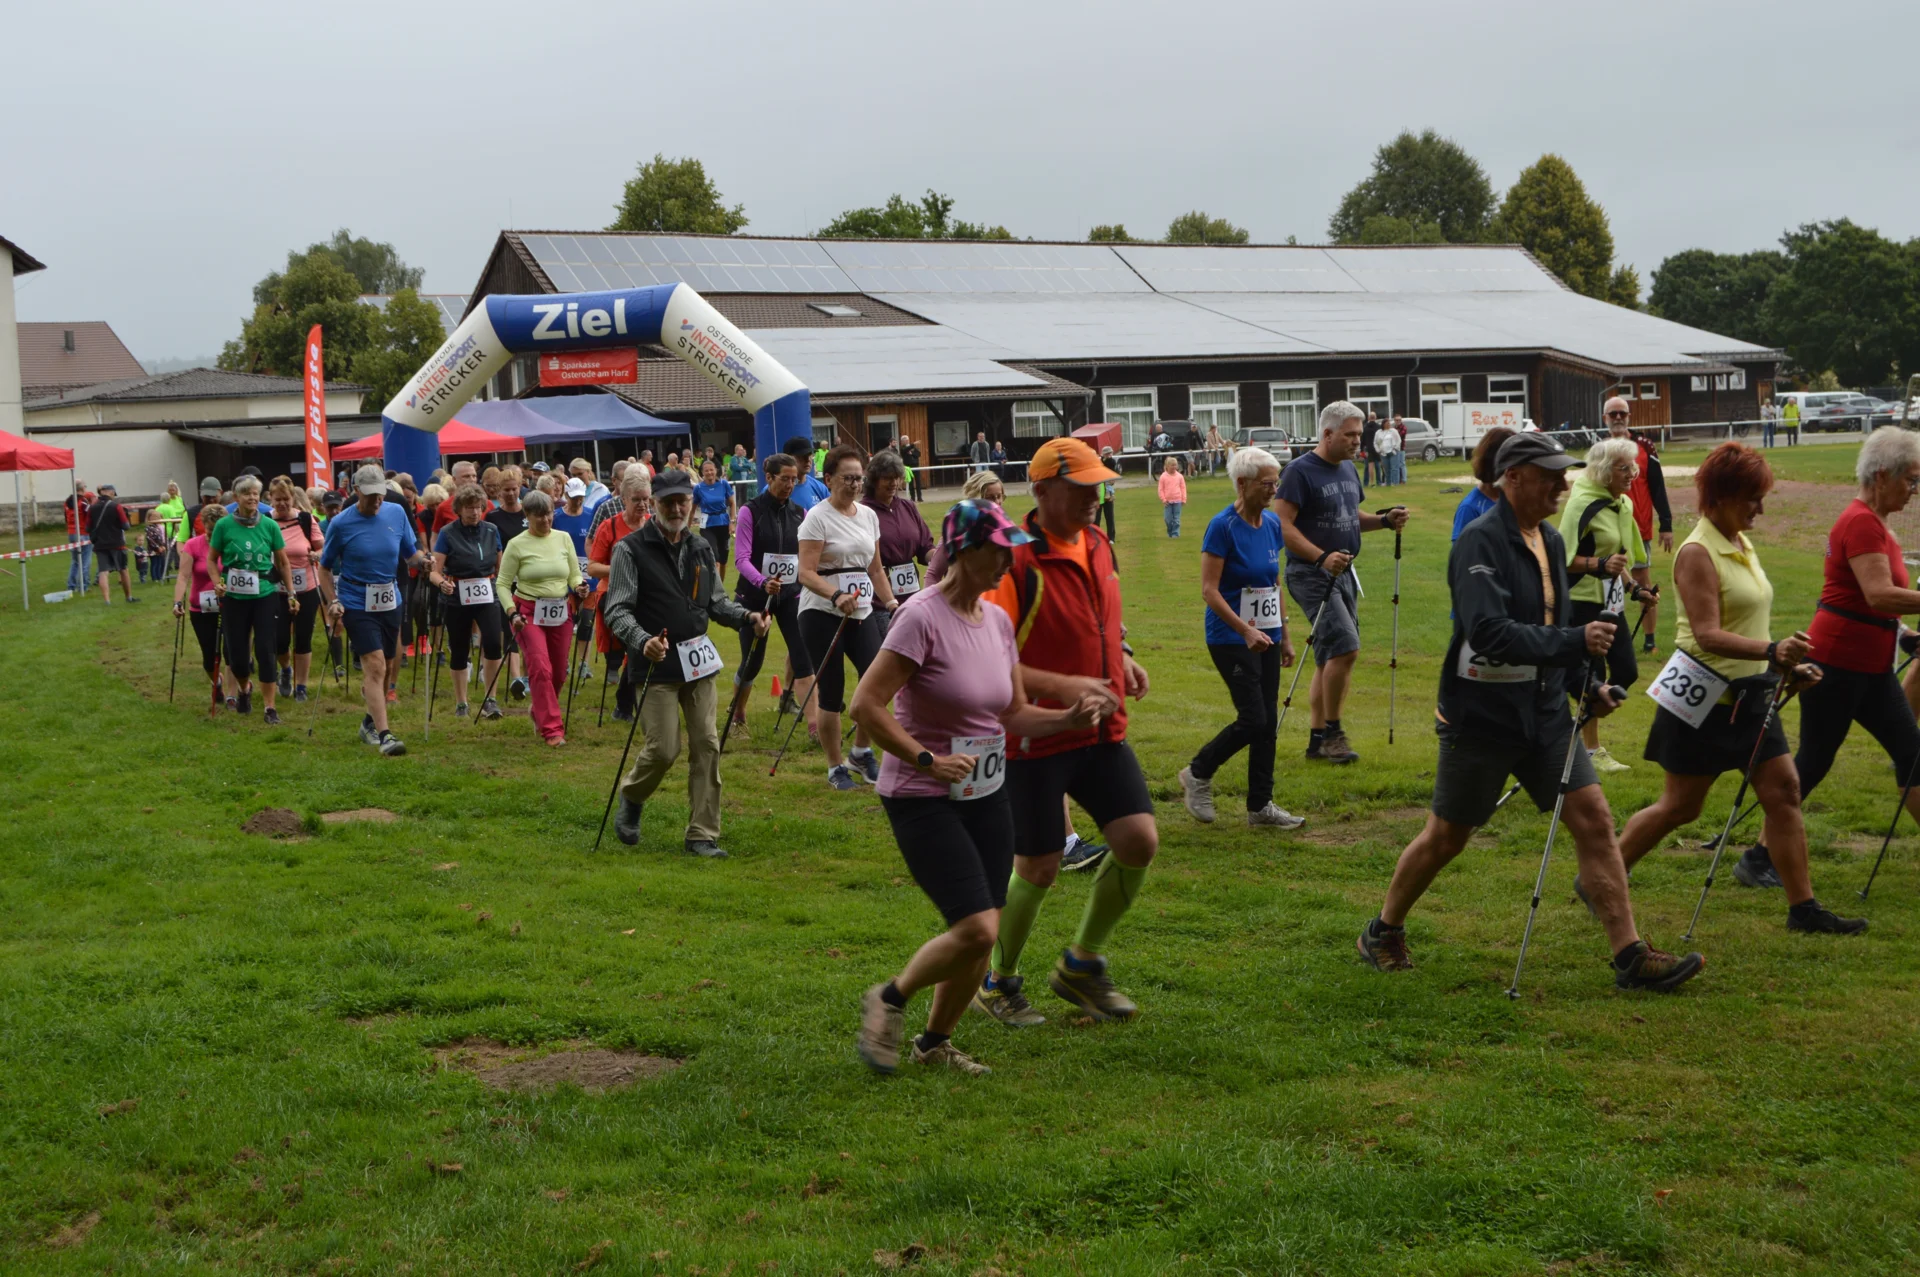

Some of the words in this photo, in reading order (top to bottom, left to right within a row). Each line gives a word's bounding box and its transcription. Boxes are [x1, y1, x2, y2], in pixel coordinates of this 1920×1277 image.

[532, 298, 628, 340] Ziel
[707, 325, 753, 365] OSTERODE
[416, 341, 455, 383] OSTERODE
[416, 335, 477, 400] INTERSPORT
[562, 361, 600, 370] Sparkasse
[678, 336, 747, 398] STRICKER
[691, 329, 761, 388] INTERSPORT
[421, 349, 487, 415] STRICKER
[561, 370, 596, 379] Osterode
[611, 369, 629, 377] Harz
[308, 343, 324, 443] Förste
[1322, 482, 1339, 497] NEW
[769, 562, 794, 575] 028
[231, 576, 254, 587] 084
[465, 585, 488, 597] 133
[848, 582, 871, 597] 050
[373, 590, 394, 604] 168
[541, 605, 564, 618] 167
[1250, 598, 1277, 617] 165
[689, 645, 714, 667] 073
[1660, 667, 1707, 707] 239
